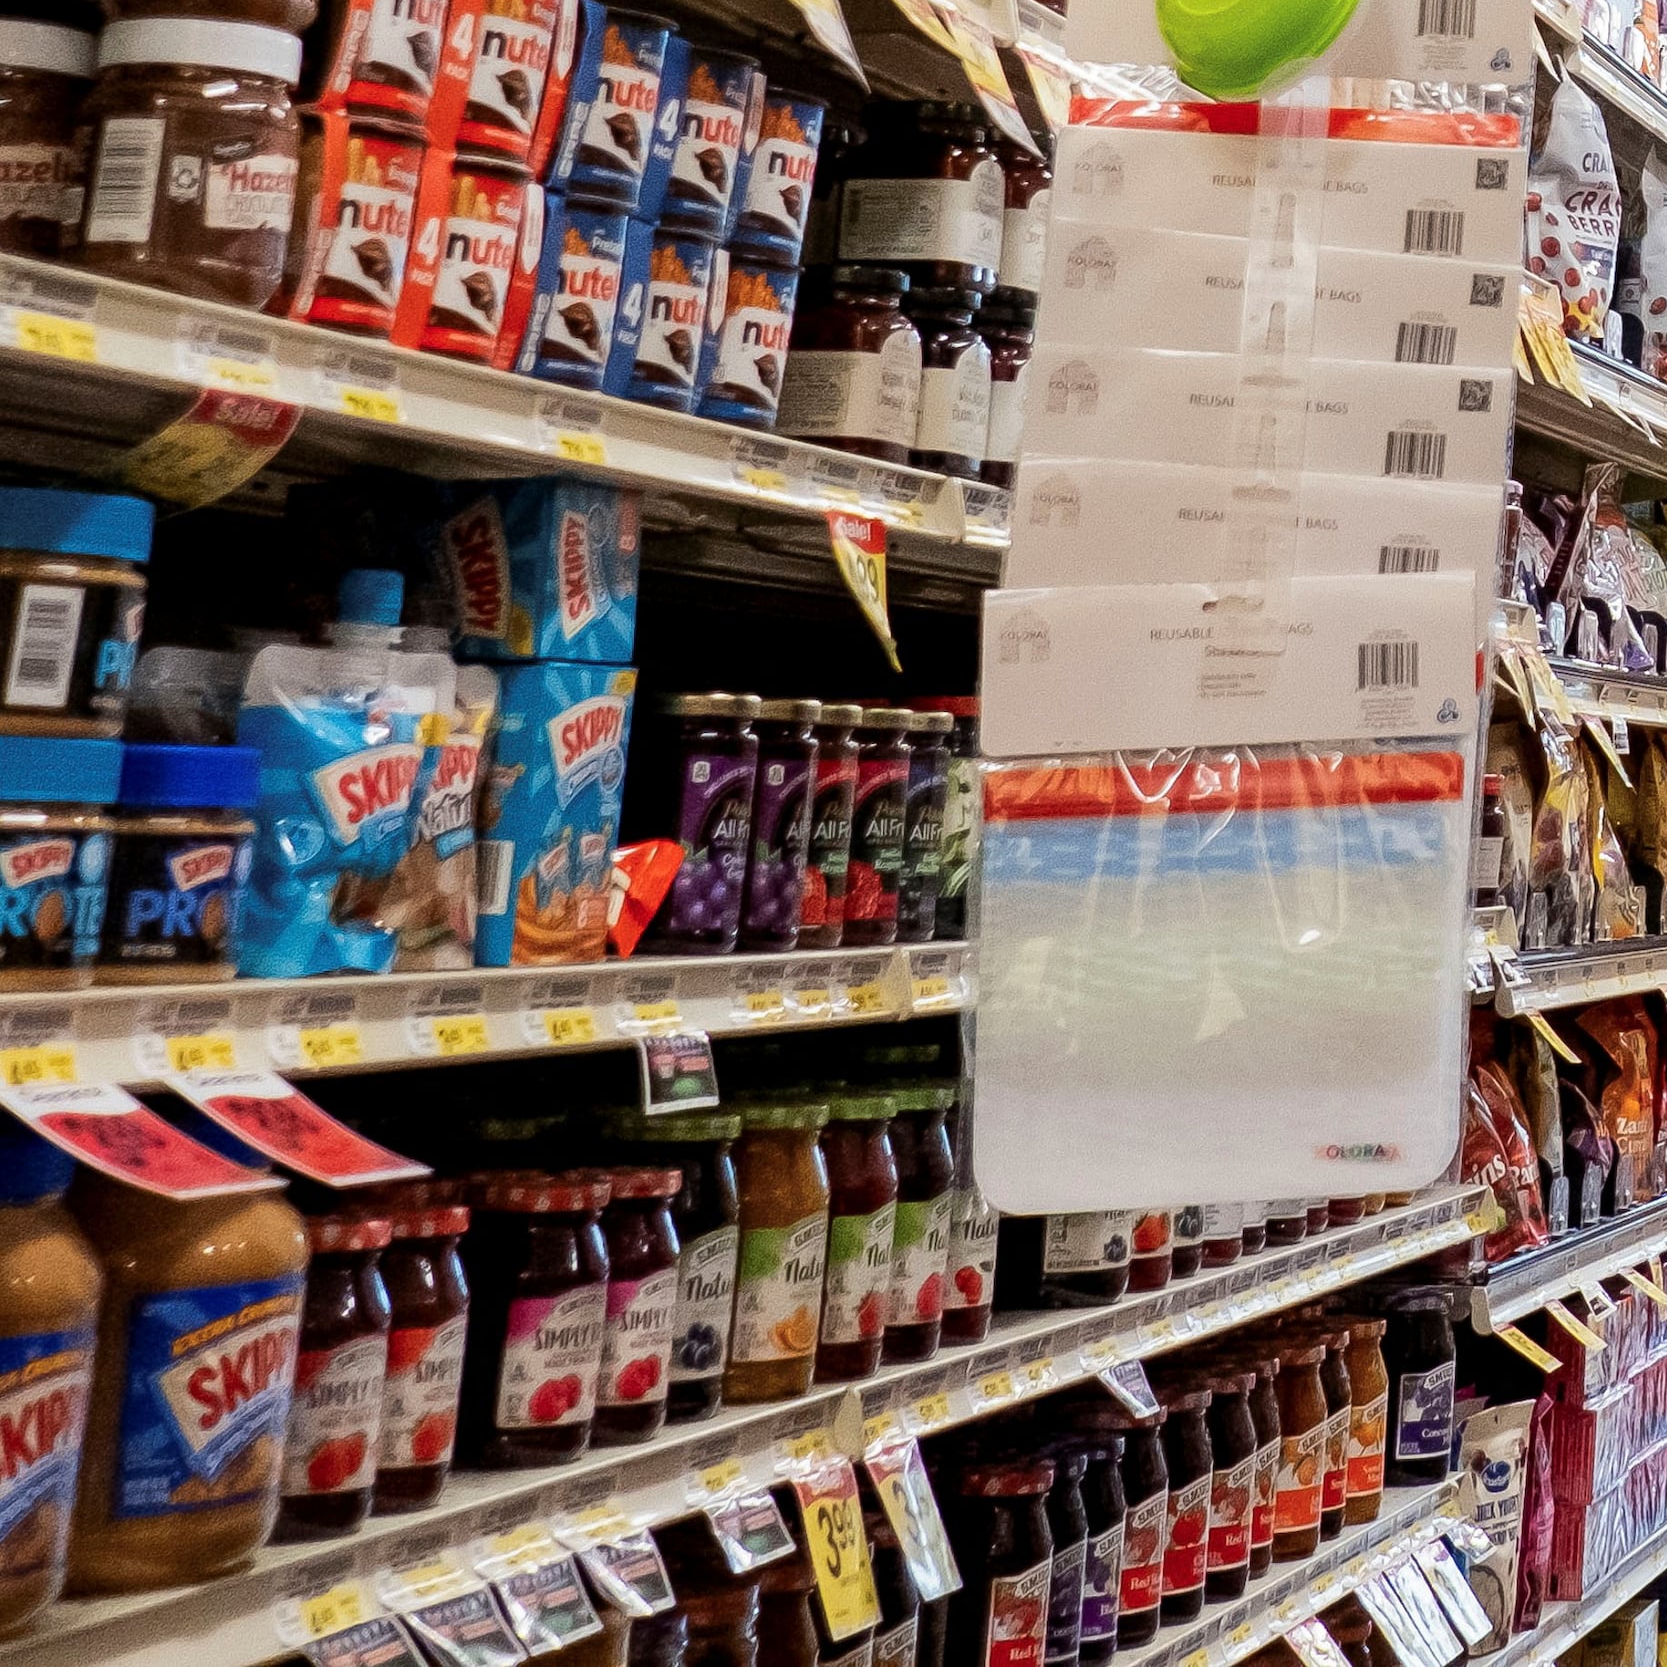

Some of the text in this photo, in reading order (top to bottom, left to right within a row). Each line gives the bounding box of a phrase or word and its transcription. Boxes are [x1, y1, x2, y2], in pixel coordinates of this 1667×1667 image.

[451, 13, 475, 60] 4
[659, 99, 679, 141] 4
[416, 217, 441, 264] 4
[624, 283, 645, 325] 4
